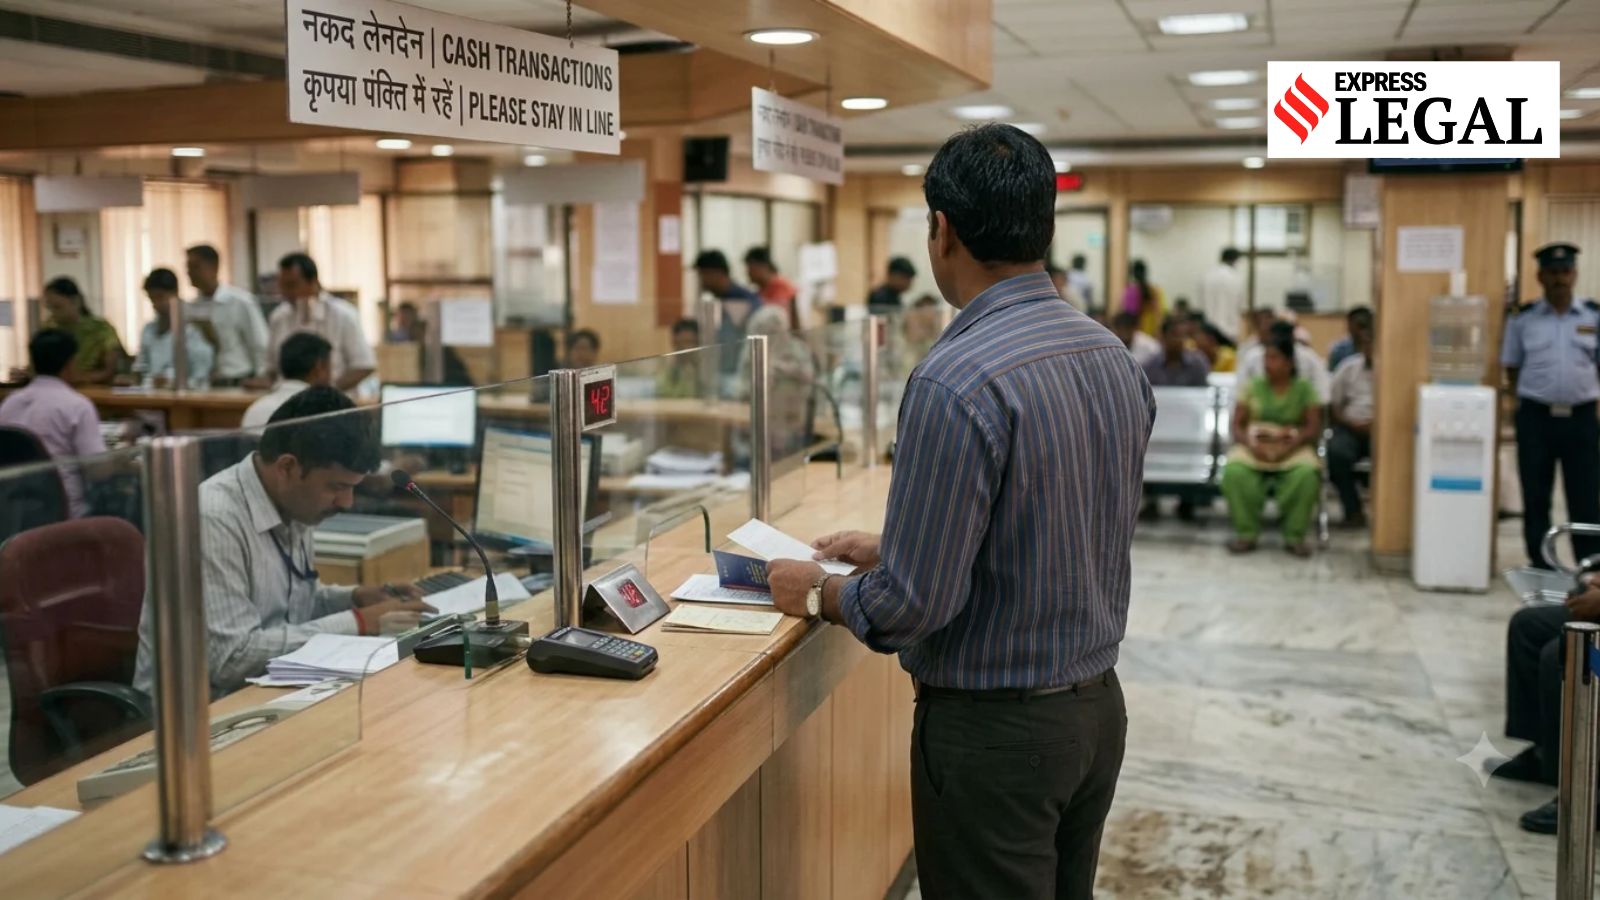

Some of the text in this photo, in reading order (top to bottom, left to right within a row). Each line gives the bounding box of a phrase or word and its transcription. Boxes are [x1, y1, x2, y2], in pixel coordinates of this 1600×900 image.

[302, 9, 355, 49] नकद
[362, 10, 424, 59] लेनदेन
[442, 34, 490, 70] CASH
[495, 44, 613, 91] TRANSACTIONS
[303, 70, 357, 112] कृपया
[363, 69, 408, 111] पंक्ति
[412, 73, 426, 113] में
[431, 78, 453, 120] रहें
[469, 91, 527, 125] PLEASE
[531, 100, 565, 130] STAY
[569, 106, 582, 132] IN
[587, 109, 614, 136] LINE
[591, 385, 610, 415] 42
